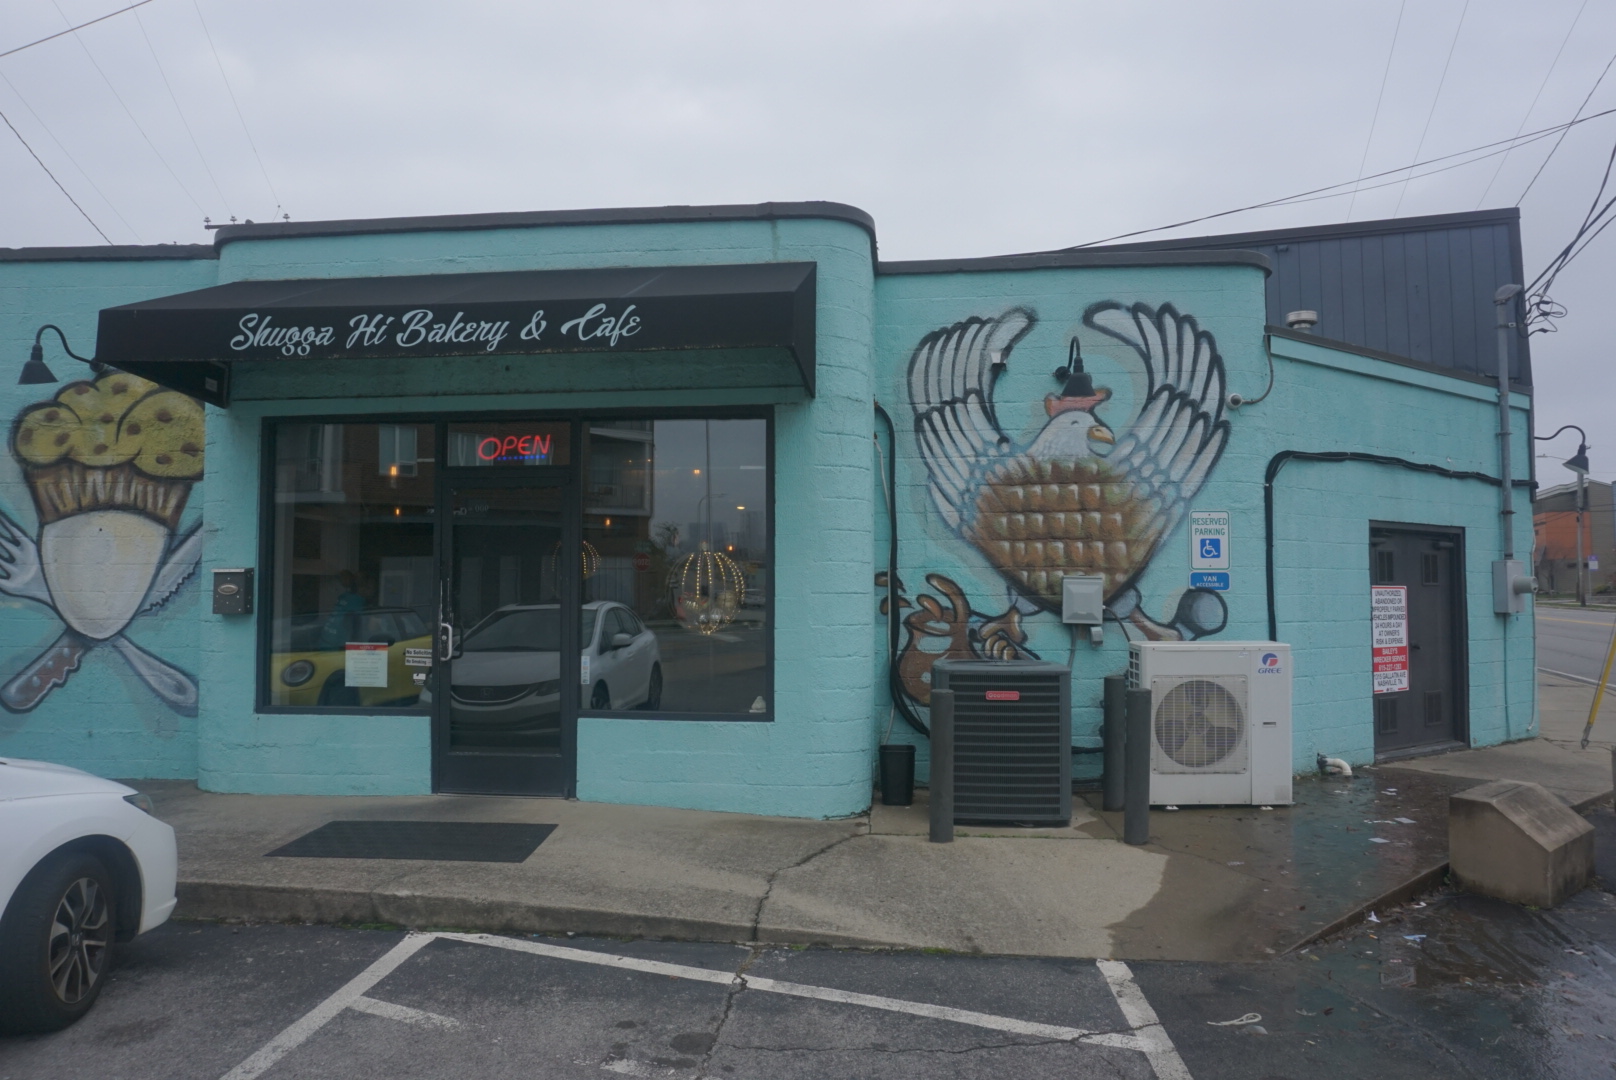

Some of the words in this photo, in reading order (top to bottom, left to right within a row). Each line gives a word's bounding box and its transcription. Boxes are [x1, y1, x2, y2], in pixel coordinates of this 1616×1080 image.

[230, 312, 336, 356] Shugga
[345, 313, 395, 349] Hi
[396, 309, 510, 351] Bakery
[520, 309, 547, 341] &
[477, 434, 551, 460] OPEN
[1192, 517, 1227, 526] RESERVED
[1194, 527, 1226, 536] PARKING
[1392, 605, 1405, 613] PARKED
[1373, 655, 1391, 663] WRECKER
[1391, 654, 1406, 662] SERVICE
